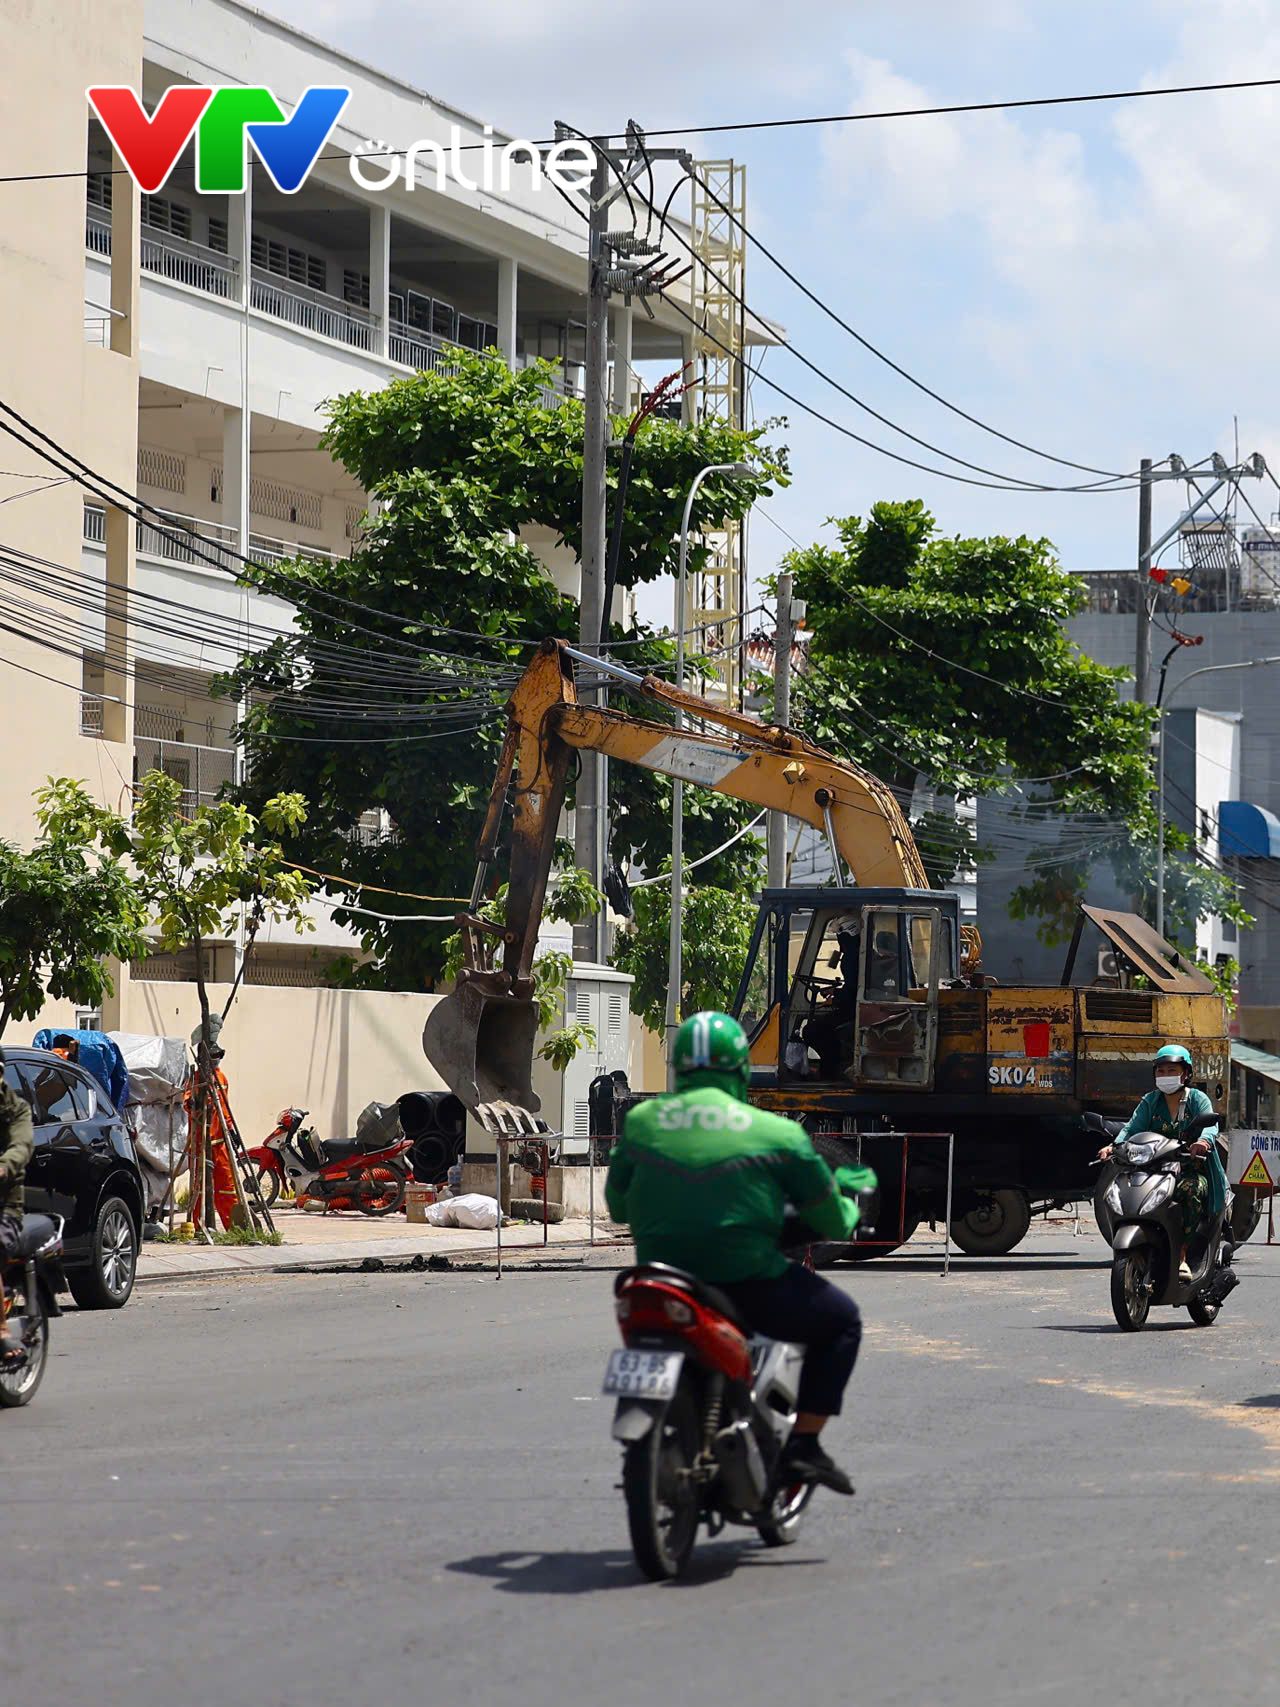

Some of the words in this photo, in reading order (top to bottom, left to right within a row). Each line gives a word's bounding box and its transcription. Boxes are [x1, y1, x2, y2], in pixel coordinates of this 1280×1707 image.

[989, 1066, 1036, 1085] SK04
[657, 1099, 752, 1132] Grab
[1250, 1134, 1269, 1151] CÔNG
